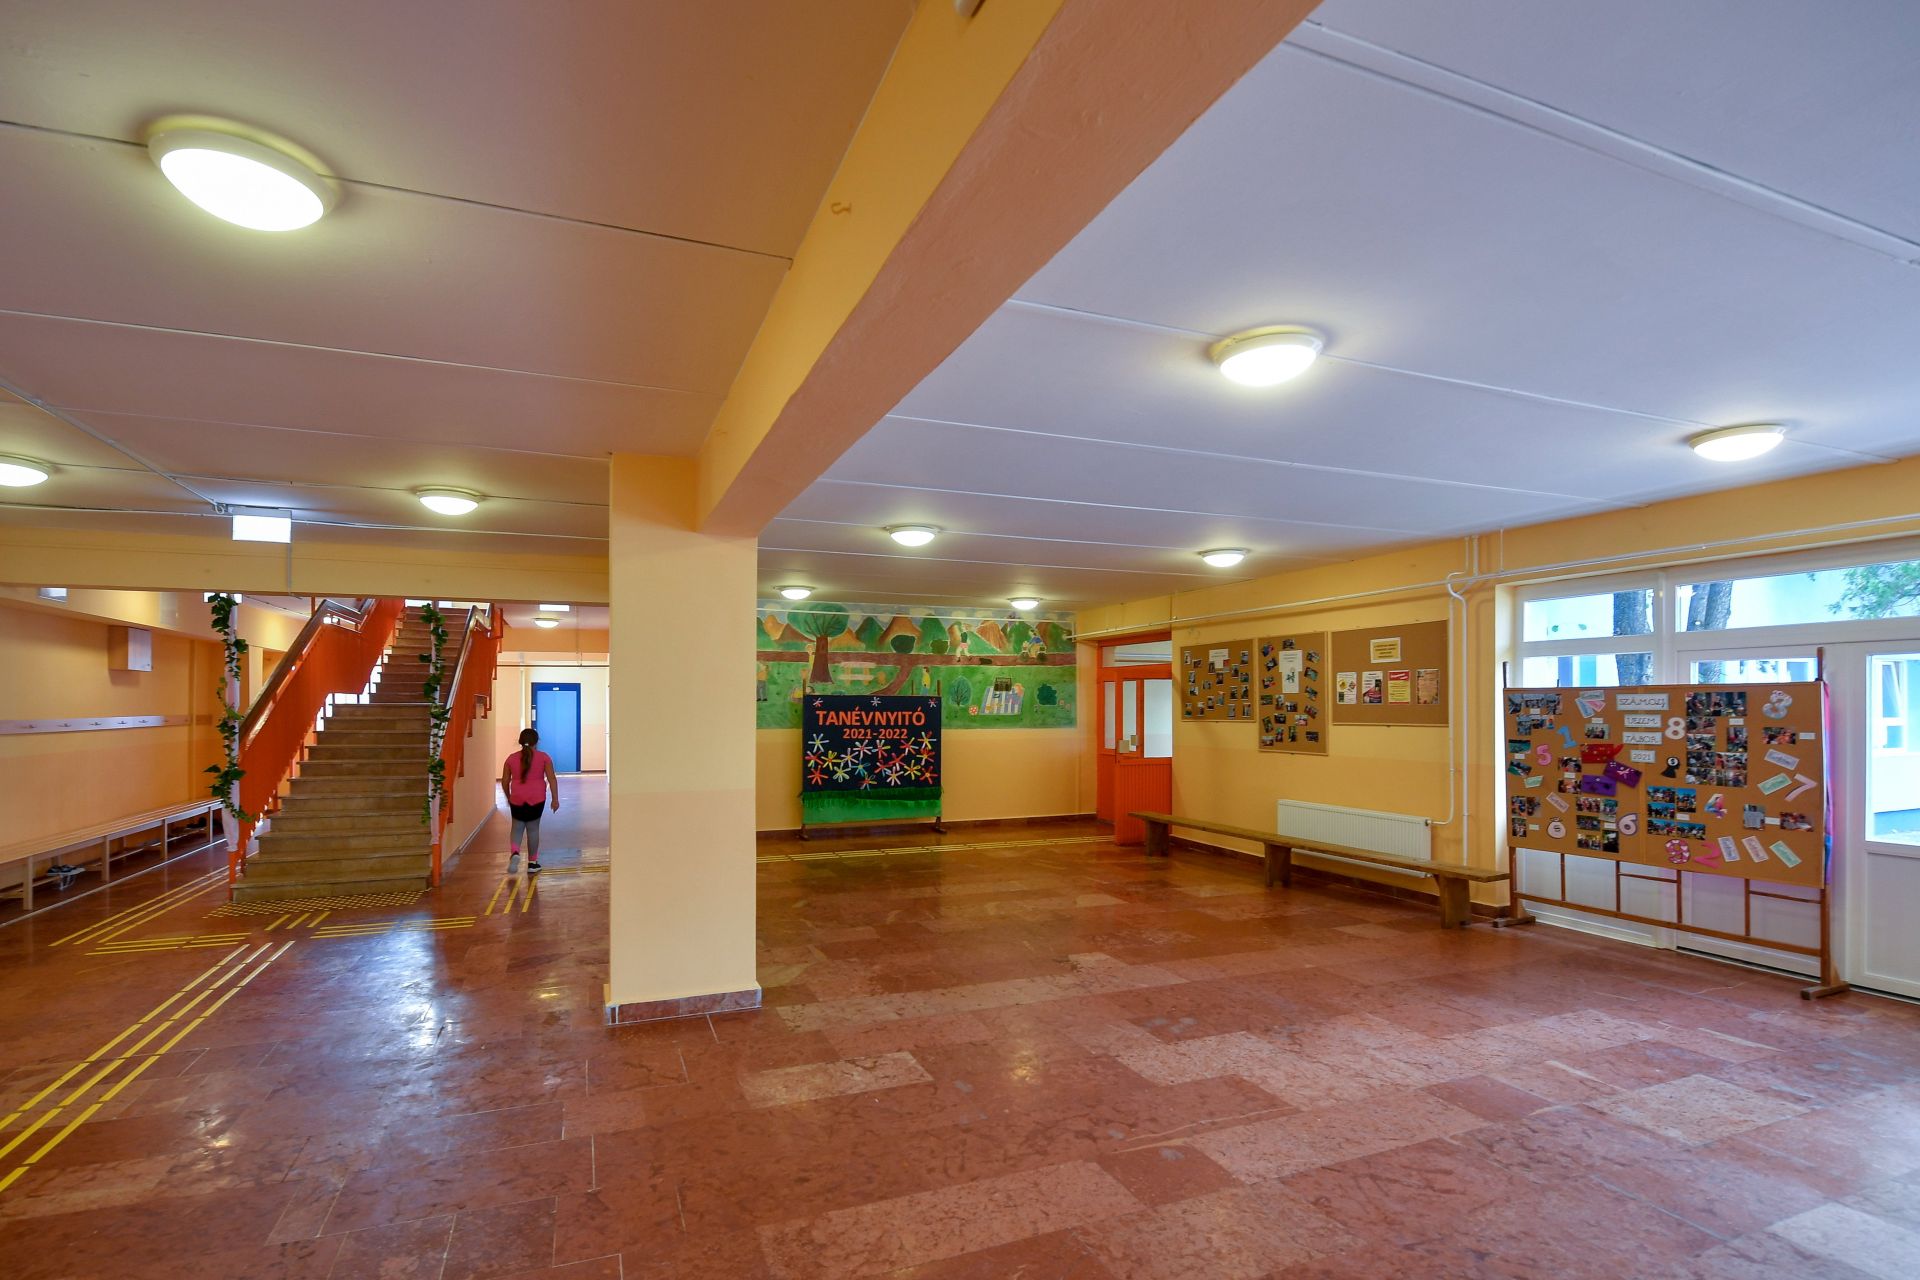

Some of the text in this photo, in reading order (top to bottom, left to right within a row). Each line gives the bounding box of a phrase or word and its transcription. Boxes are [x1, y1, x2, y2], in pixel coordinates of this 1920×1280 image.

[815, 705, 926, 726] TANÉVNYITÓ
[842, 728, 908, 739] 2021-2022
[1557, 725, 1578, 749] 1
[1665, 716, 1686, 740] 8
[1536, 744, 1553, 766] 5
[1784, 773, 1818, 802] 7
[1704, 793, 1728, 819] 4
[1618, 812, 1638, 836] 6
[1665, 839, 1690, 864] 9
[1693, 842, 1722, 869] 2
